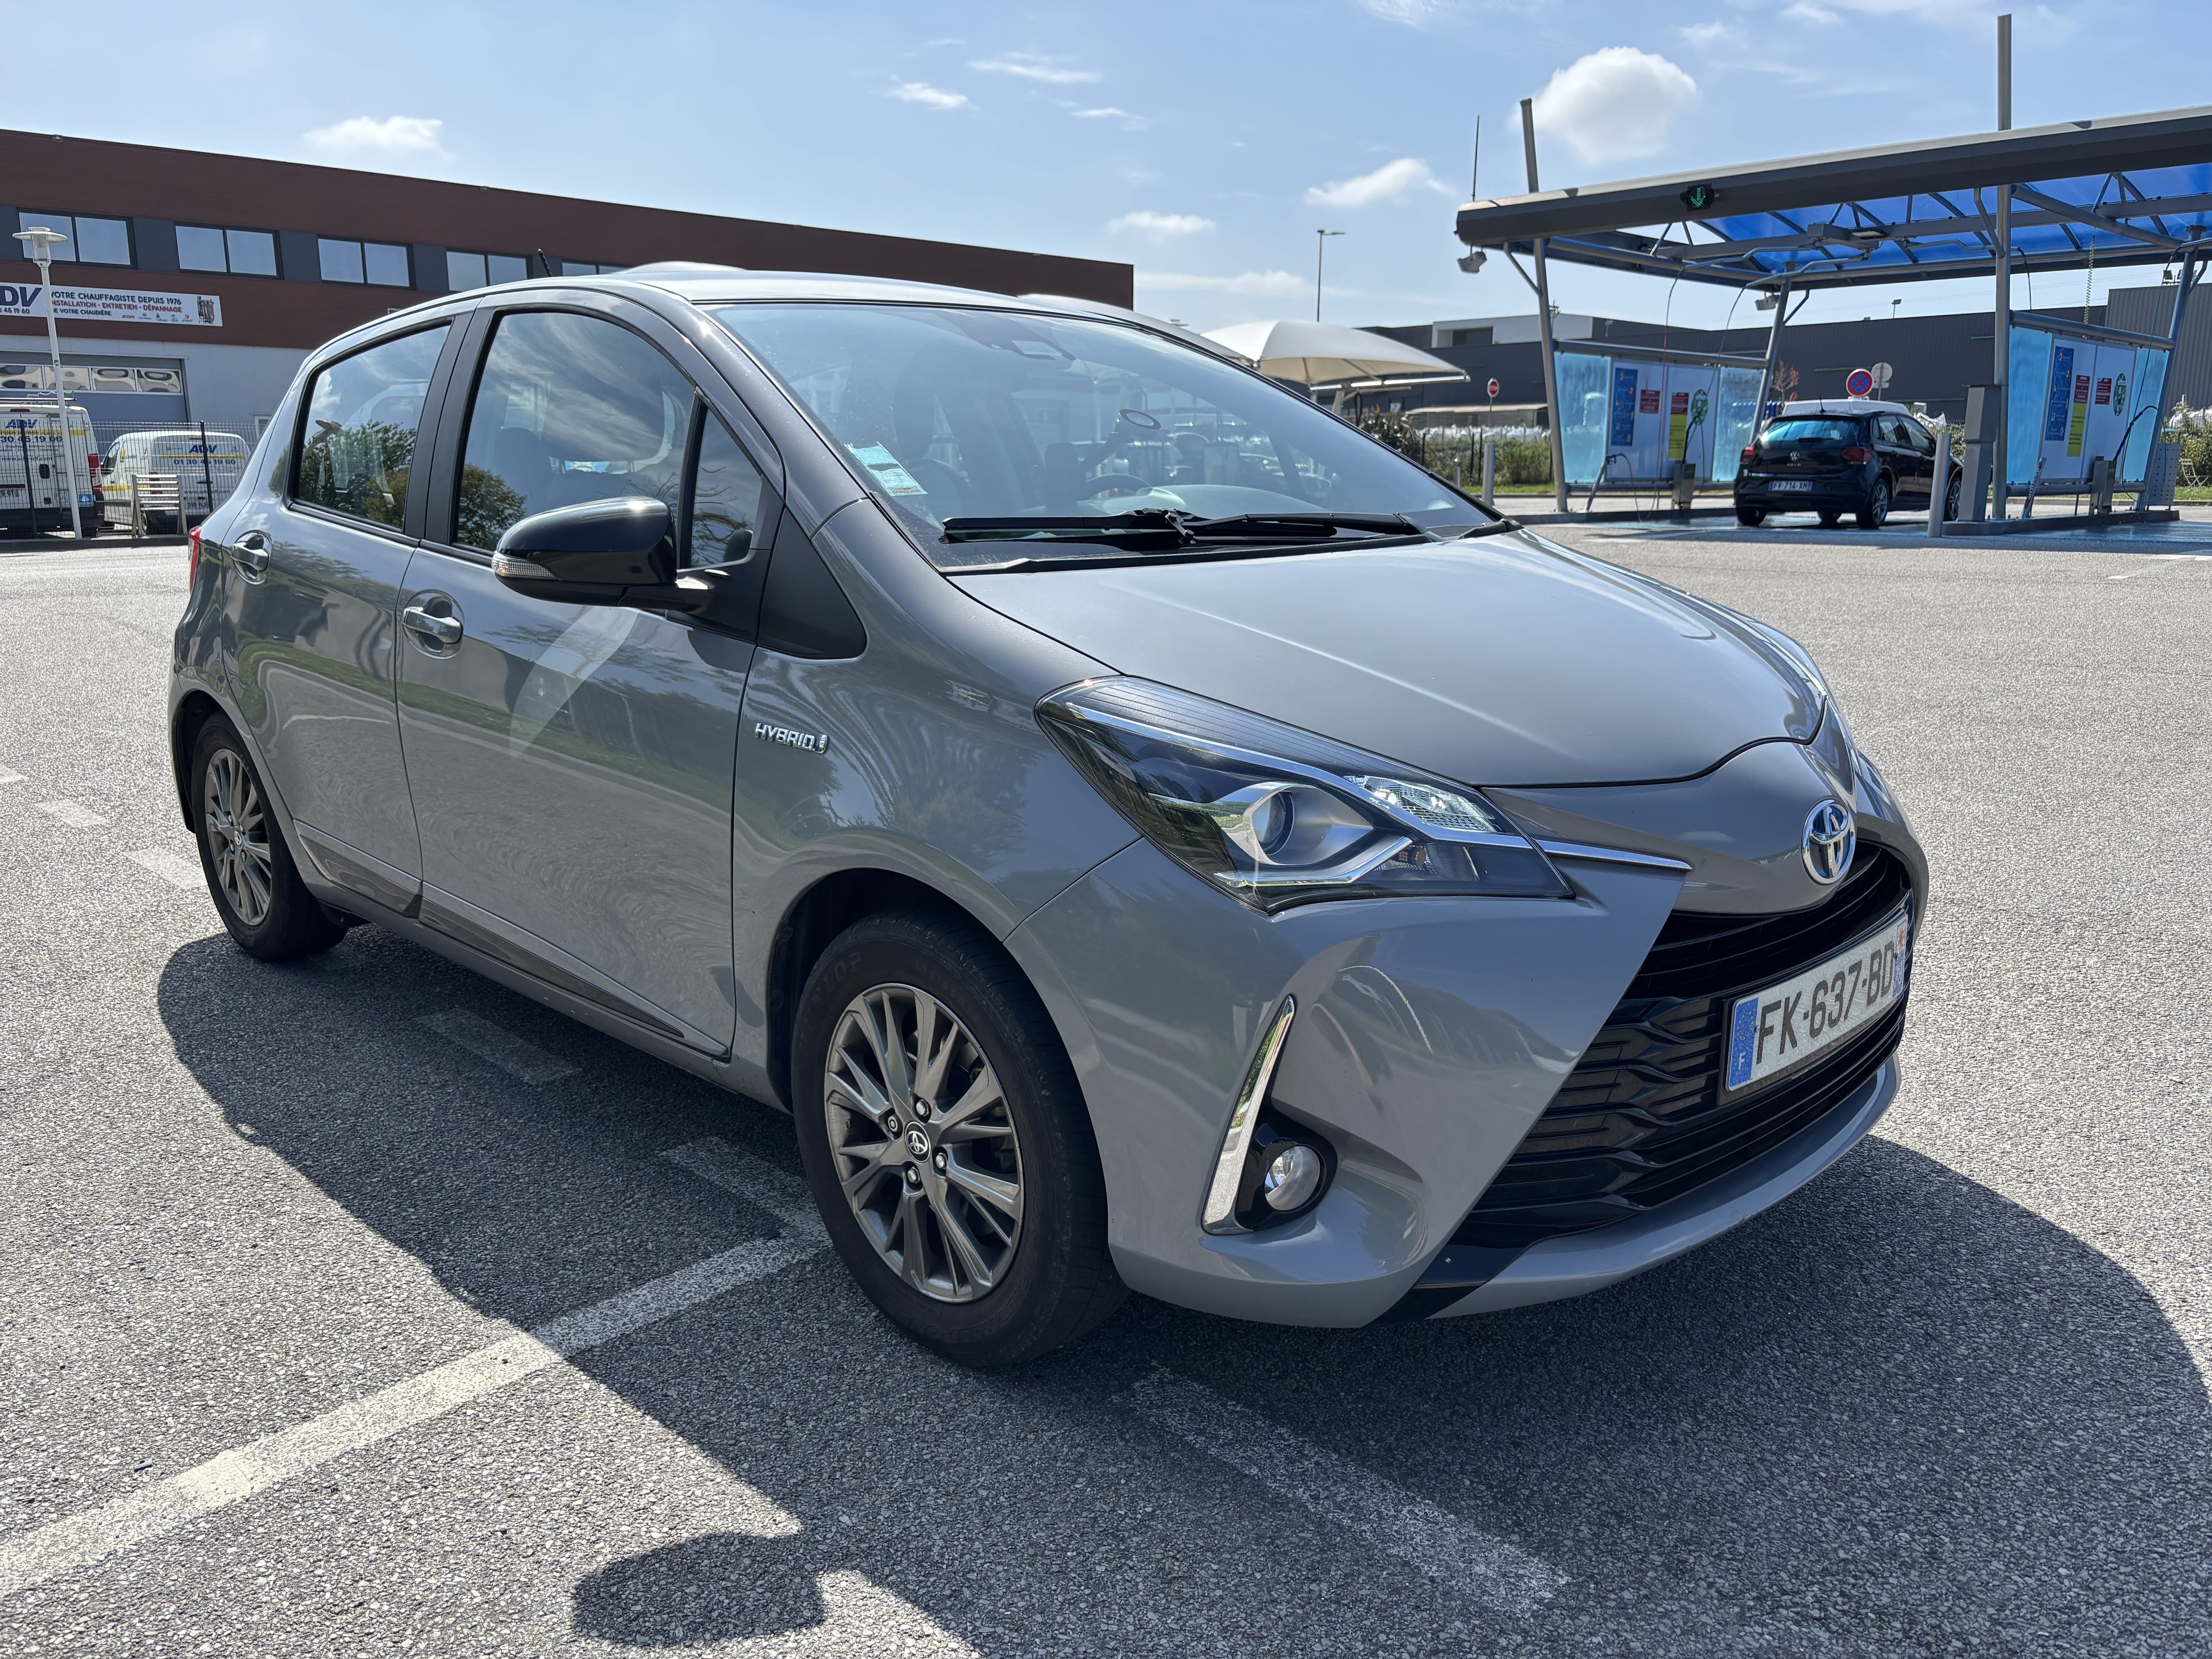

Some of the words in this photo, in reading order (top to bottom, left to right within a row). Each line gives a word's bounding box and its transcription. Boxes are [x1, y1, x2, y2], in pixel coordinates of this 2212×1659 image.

[78, 293, 136, 302] CHAUFFAGISTE
[143, 304, 182, 313] DÉPANNAGE
[755, 723, 815, 750] HYBRID
[1756, 941, 1894, 1065] FK-637-BD
[1738, 1052, 1745, 1070] F
